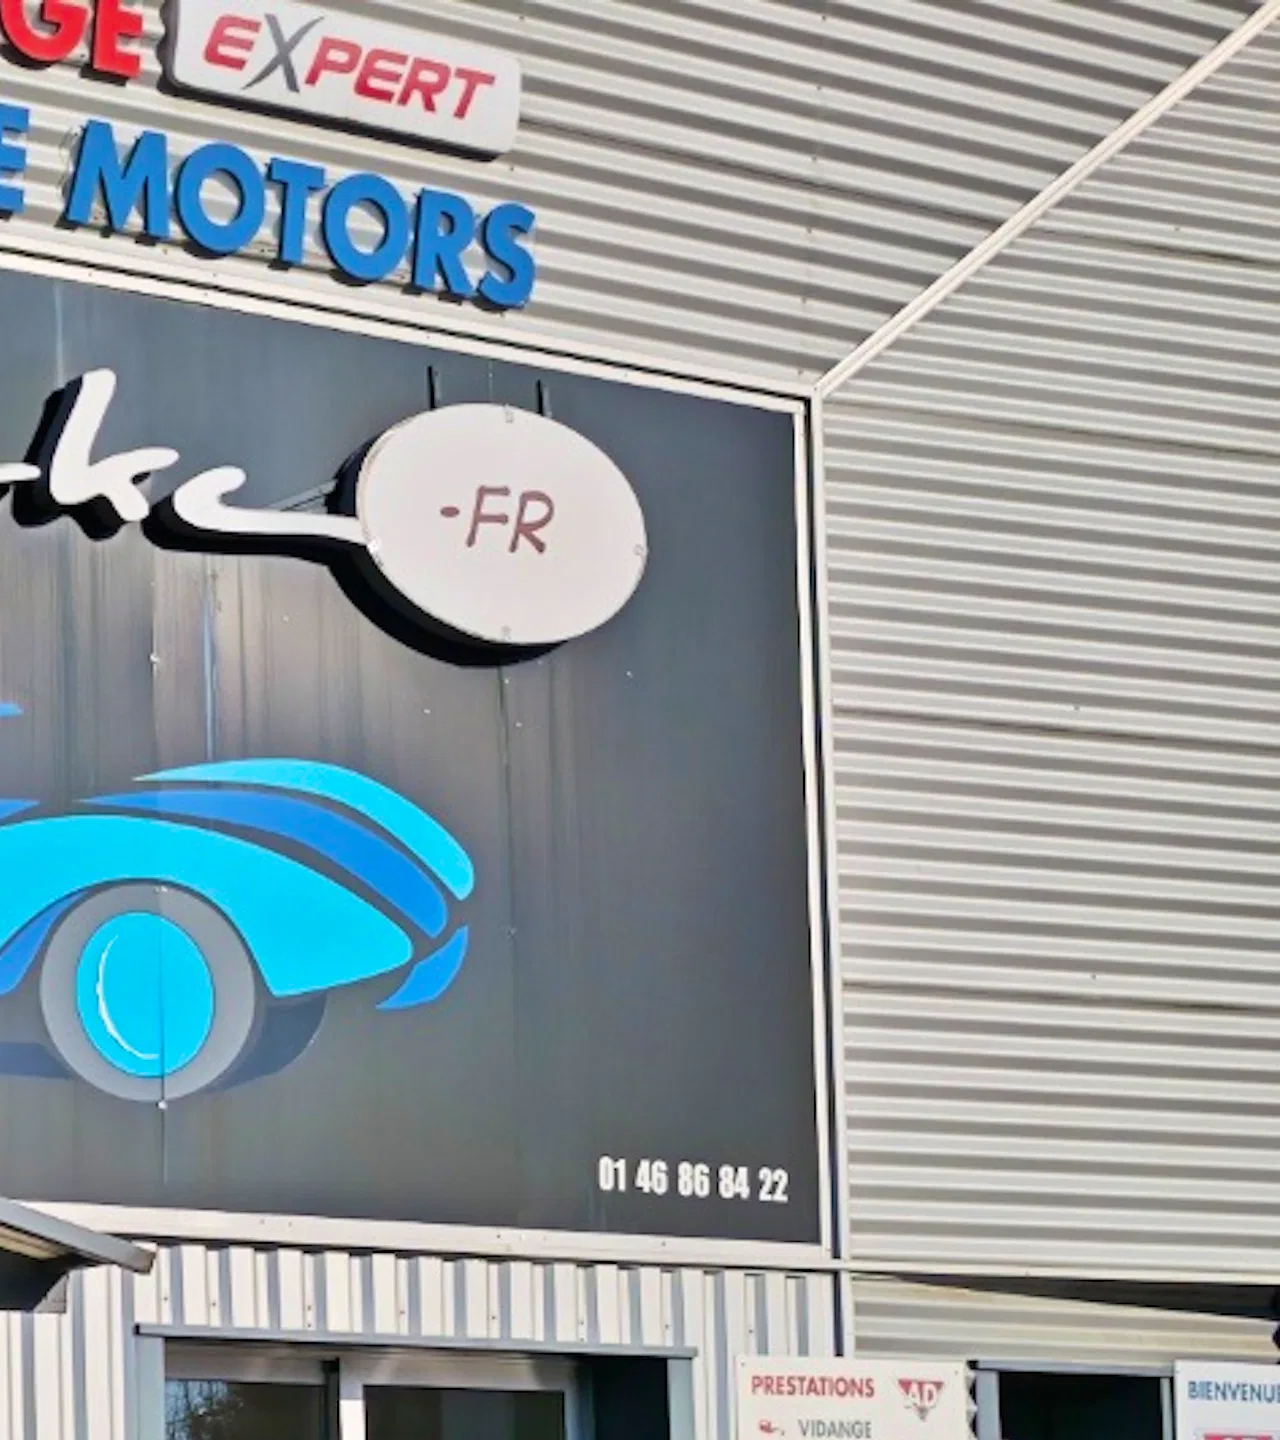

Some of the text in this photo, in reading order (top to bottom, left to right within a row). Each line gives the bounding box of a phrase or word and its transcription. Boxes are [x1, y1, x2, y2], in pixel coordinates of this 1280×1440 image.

[201, 12, 497, 120] EXPERT
[62, 119, 537, 308] MOTORS
[598, 1155, 789, 1203] 01 46 86 84 22
[751, 1375, 876, 1398] PRESTATIONS
[798, 1419, 873, 1440] VIDANGE
